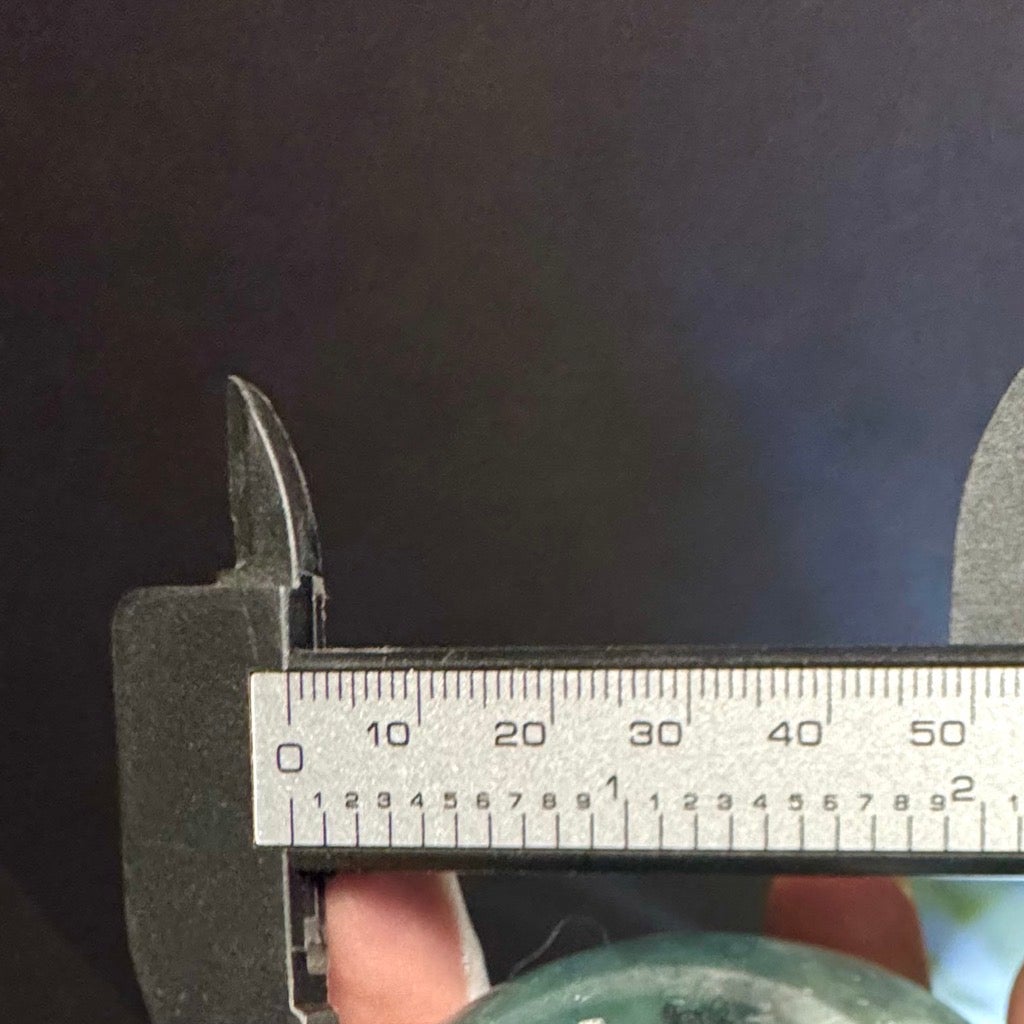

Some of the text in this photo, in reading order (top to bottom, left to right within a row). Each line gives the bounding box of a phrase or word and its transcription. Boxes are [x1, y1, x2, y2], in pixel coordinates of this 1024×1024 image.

[367, 721, 410, 747] 10
[494, 721, 546, 747] 20
[629, 720, 683, 747] 30
[767, 720, 823, 747] 40
[909, 719, 966, 747] 50
[276, 742, 303, 773] 0
[313, 791, 323, 808] 1
[344, 791, 359, 809] 2
[376, 791, 392, 809] 3
[410, 791, 424, 809] 4
[443, 791, 458, 810] 5
[476, 791, 491, 810] 6
[508, 792, 523, 810] 7
[541, 792, 557, 810] 8
[576, 792, 591, 810] 9
[605, 774, 618, 801] 1
[649, 792, 659, 811] 1
[683, 792, 699, 811] 2
[716, 792, 733, 811] 3
[752, 793, 768, 811] 4
[788, 793, 804, 811] 5
[822, 793, 839, 811] 6
[856, 793, 874, 812] 7
[893, 793, 910, 812] 8
[929, 793, 947, 812] 9
[951, 775, 975, 802] 2
[1008, 793, 1019, 813] 1
